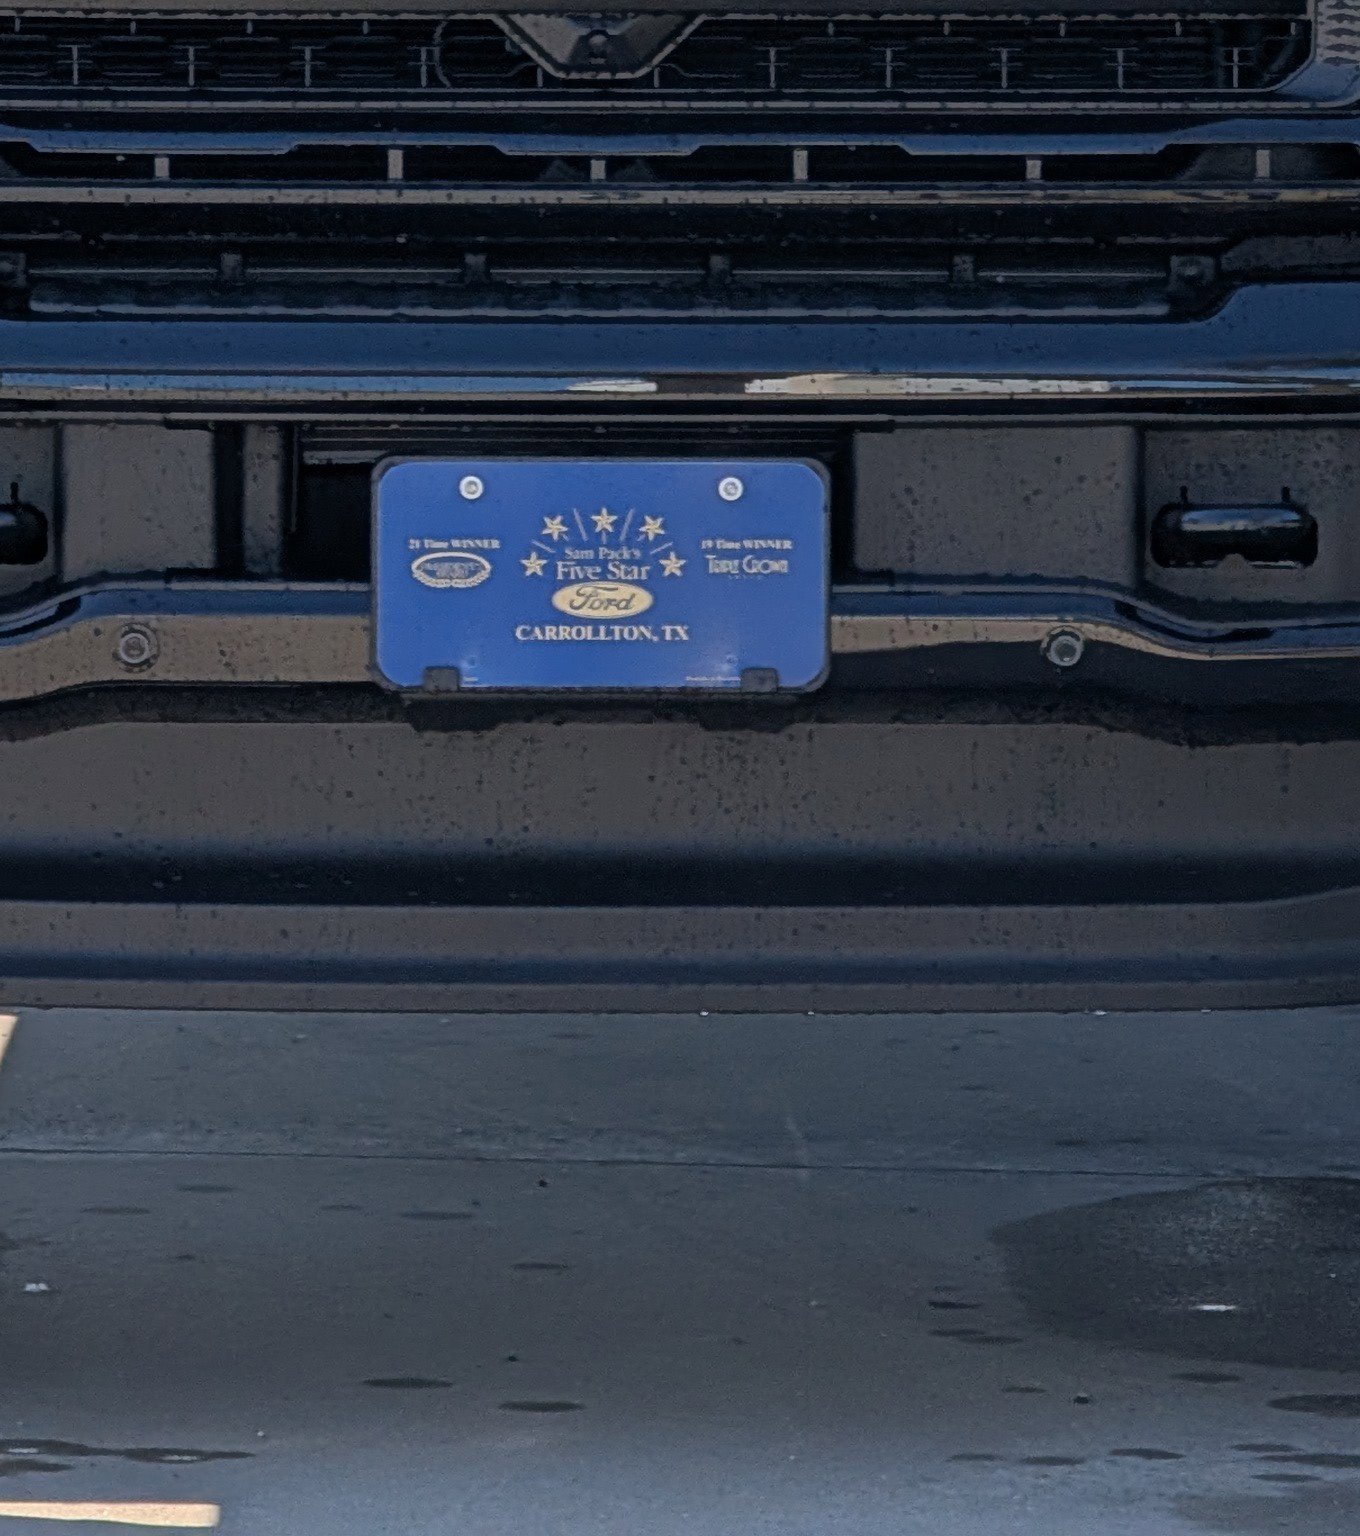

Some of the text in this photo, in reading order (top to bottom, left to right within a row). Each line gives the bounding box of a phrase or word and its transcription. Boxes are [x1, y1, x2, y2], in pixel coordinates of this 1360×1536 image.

[451, 539, 500, 548] WINNER
[743, 540, 792, 549] WINNER
[565, 546, 641, 560] Sam Pack's
[556, 560, 651, 580] Five Star
[569, 585, 635, 610] Ford
[515, 625, 689, 642] CARROLLTON, TX
